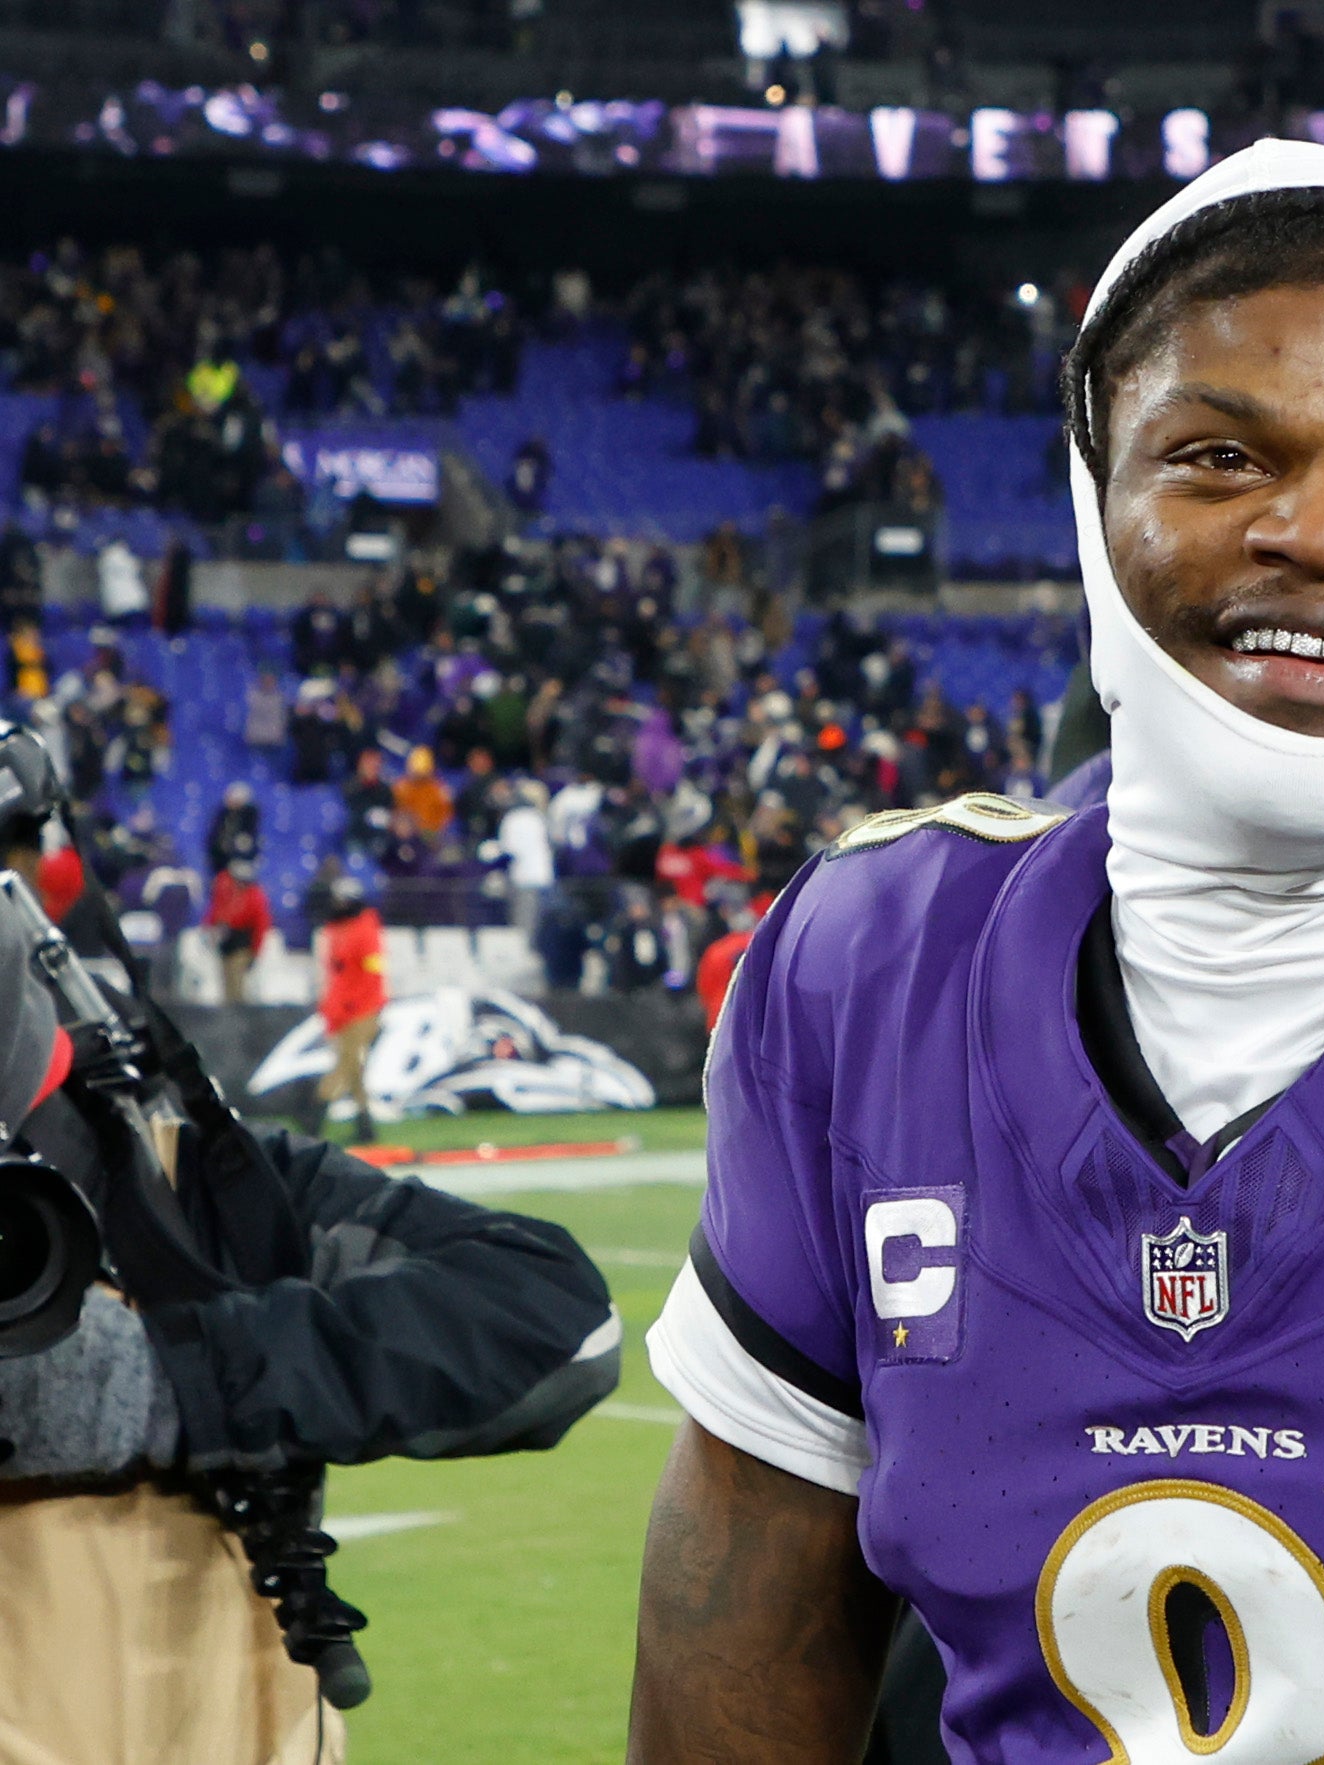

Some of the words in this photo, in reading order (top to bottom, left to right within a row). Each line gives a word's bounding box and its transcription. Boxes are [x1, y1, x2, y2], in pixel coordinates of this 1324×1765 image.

[865, 1198, 957, 1320] C
[1156, 1274, 1216, 1319] NFL
[1085, 1424, 1307, 1459] RAVENS
